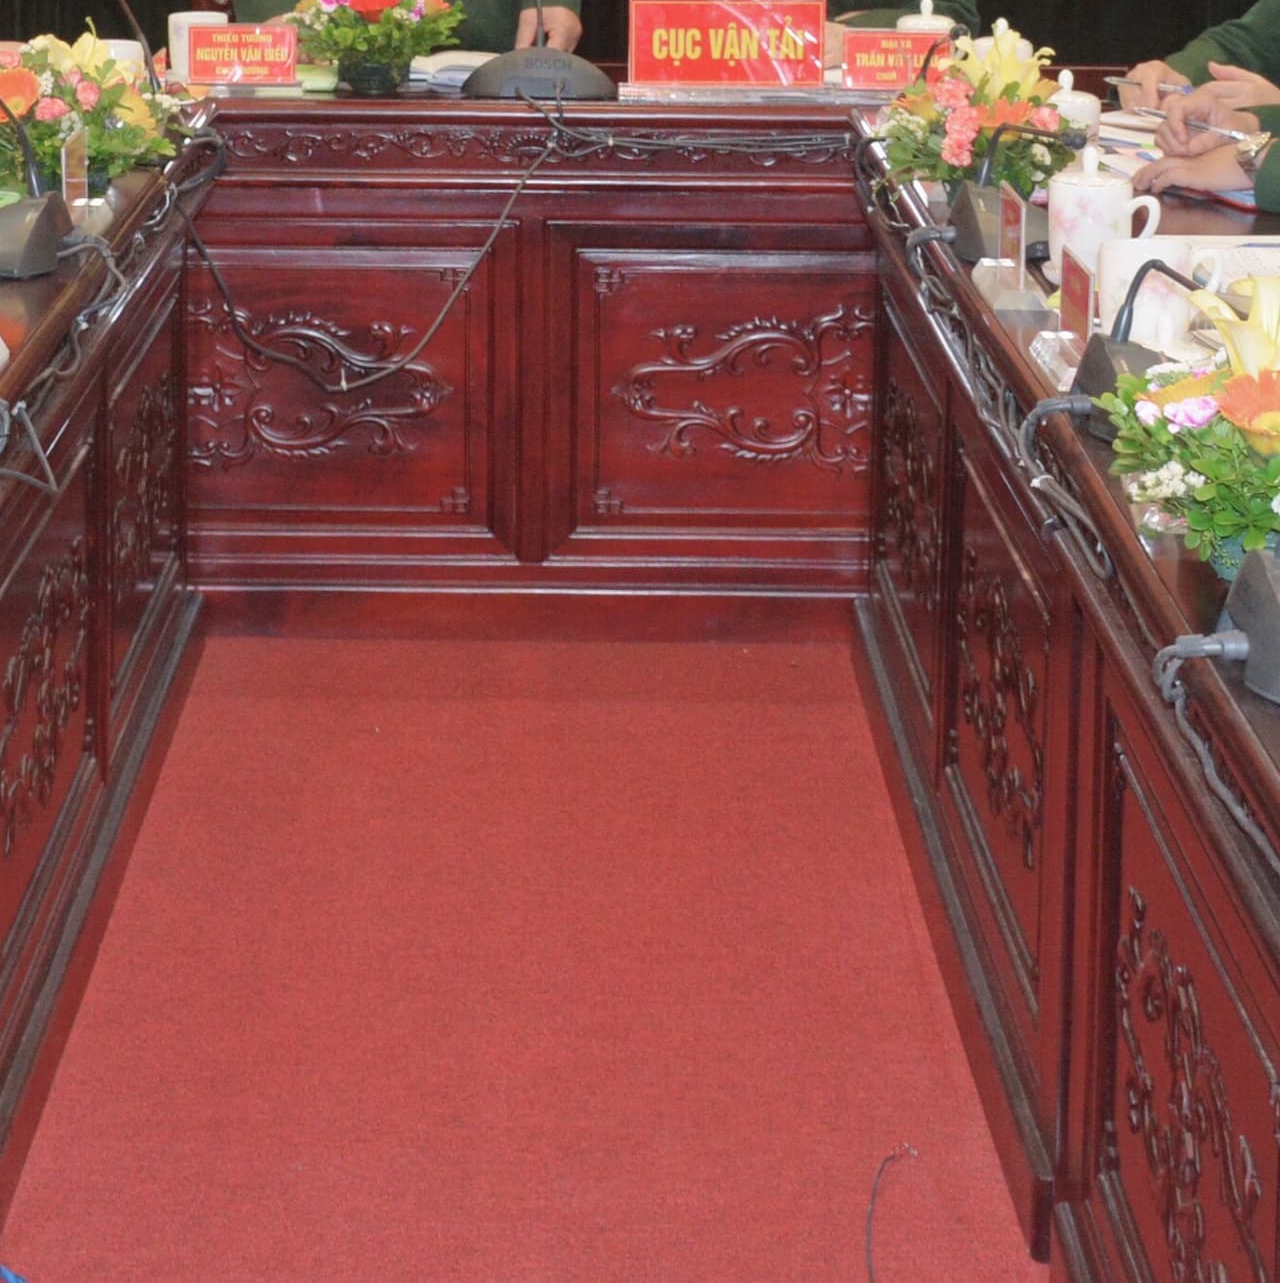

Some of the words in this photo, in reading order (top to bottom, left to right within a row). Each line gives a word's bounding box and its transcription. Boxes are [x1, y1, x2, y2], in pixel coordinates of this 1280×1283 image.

[652, 29, 702, 67] CỤC
[709, 22, 760, 67] VẬN
[767, 15, 807, 60] TẢI
